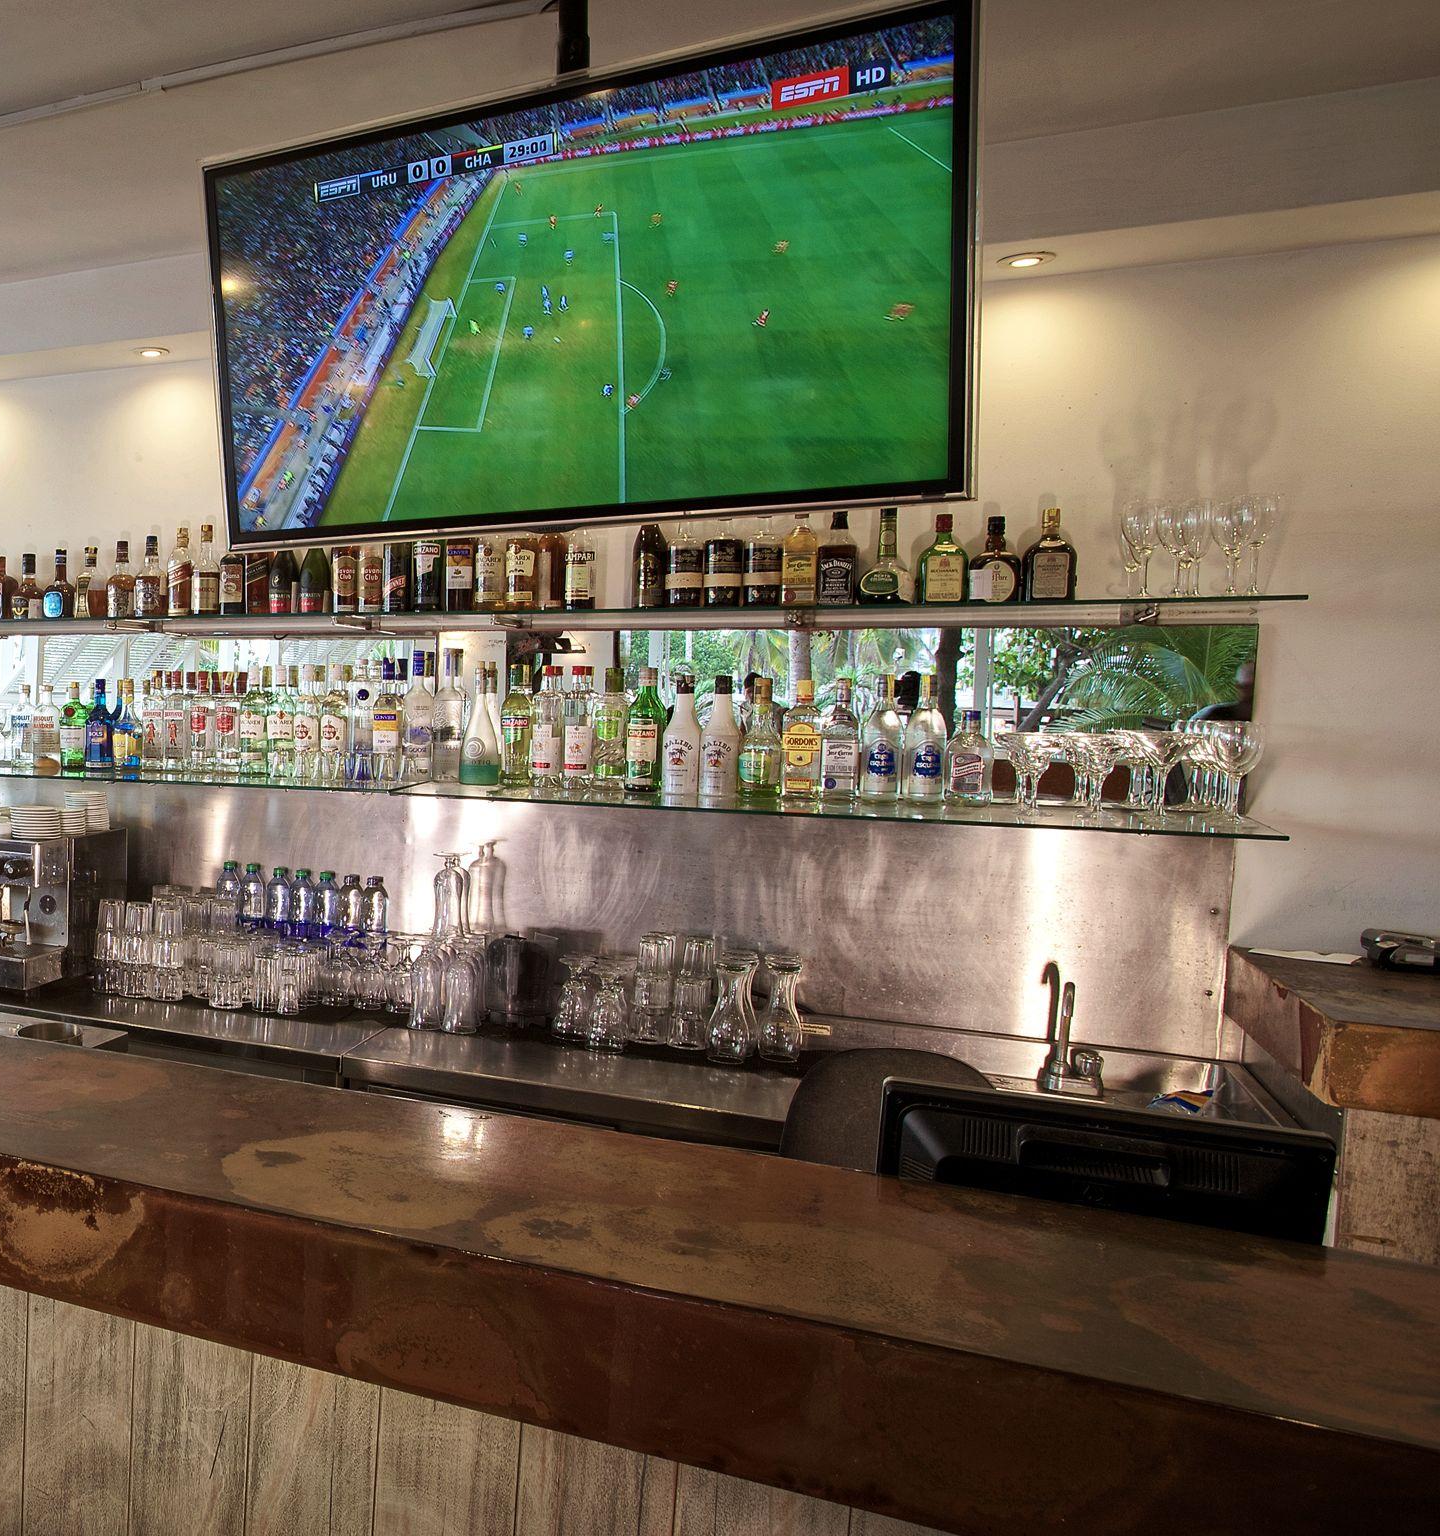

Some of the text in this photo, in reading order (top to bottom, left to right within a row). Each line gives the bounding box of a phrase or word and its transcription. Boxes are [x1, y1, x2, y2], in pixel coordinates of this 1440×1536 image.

[779, 66, 886, 102] ESPN HD
[319, 179, 358, 198] ESPN
[371, 172, 398, 188] URU
[411, 163, 424, 180] 0
[434, 158, 447, 175] 0
[464, 153, 492, 169] GHA
[564, 552, 595, 561] CAMPARI
[820, 559, 833, 571] JACK
[221, 571, 240, 583] Coloma
[364, 573, 379, 581] Club
[502, 718, 528, 727] CINZANO
[628, 729, 656, 738] CINZANO
[663, 739, 694, 751] MALIBU
[701, 740, 732, 753] MALIBU
[784, 736, 818, 746] GORDON'S
